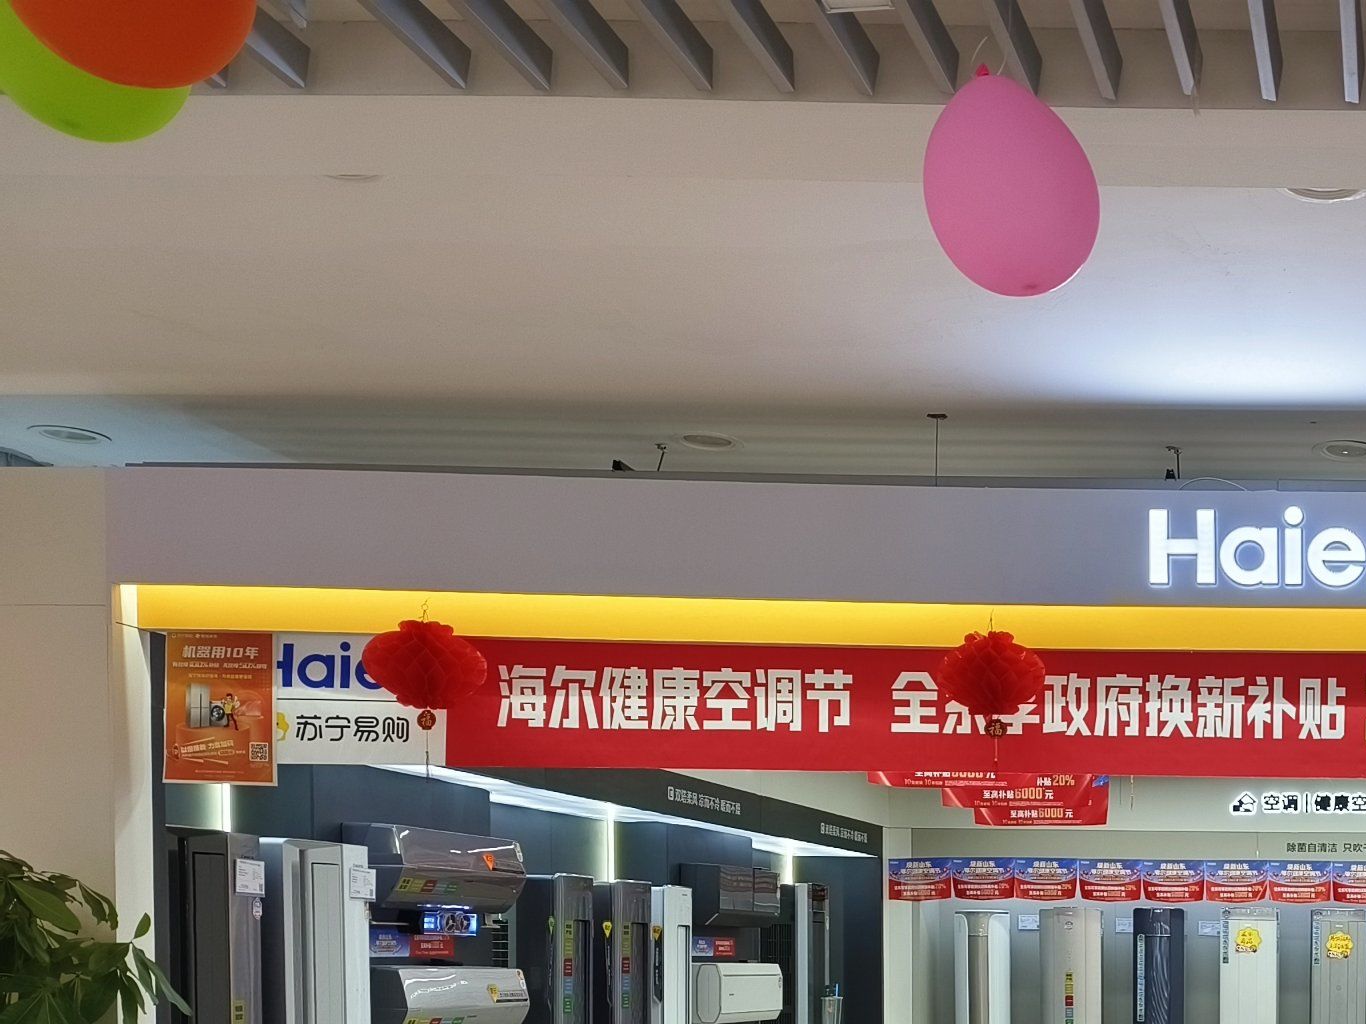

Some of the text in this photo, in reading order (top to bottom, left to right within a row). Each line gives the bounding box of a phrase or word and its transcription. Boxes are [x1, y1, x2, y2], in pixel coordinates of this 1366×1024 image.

[182, 645, 259, 660] 机器用10年
[497, 665, 852, 733] 海尔健康空调节
[296, 715, 410, 742] 苏宁易购
[1263, 794, 1298, 812] 空调
[1286, 842, 1338, 853] 除菌自清洁
